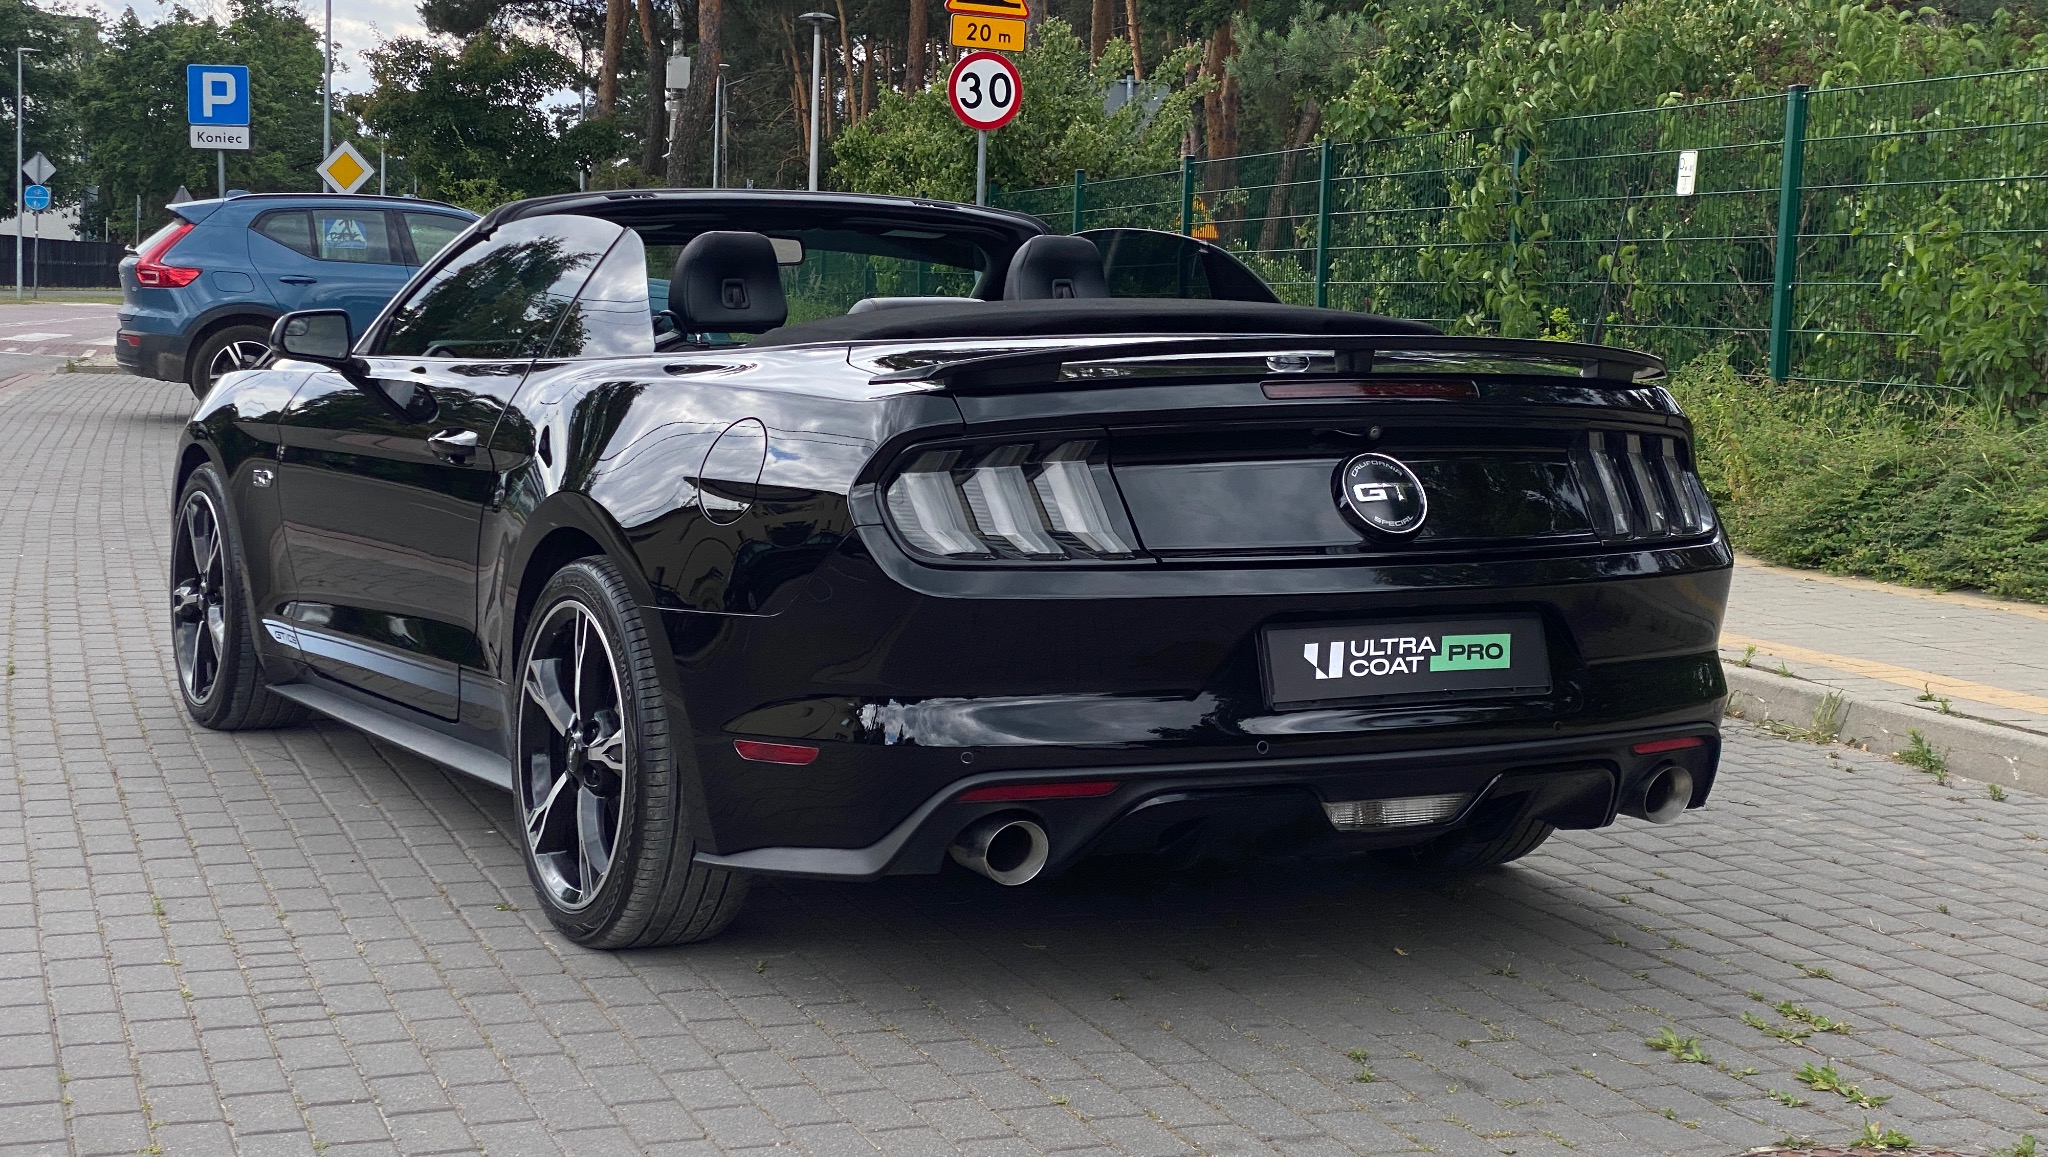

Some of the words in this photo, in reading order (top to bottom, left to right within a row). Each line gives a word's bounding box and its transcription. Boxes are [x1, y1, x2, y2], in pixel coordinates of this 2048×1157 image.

[966, 22, 992, 42] 20
[998, 33, 1011, 43] m
[202, 71, 236, 118] P
[960, 72, 1012, 109] 30
[197, 131, 242, 144] Koniec
[1351, 460, 1403, 478] CALIFORNIA
[1352, 482, 1413, 502] GT
[1373, 515, 1414, 527] SPECIAL
[1350, 636, 1437, 657] ULTRA
[1448, 643, 1504, 662] PRO
[1349, 656, 1425, 677] COAT
